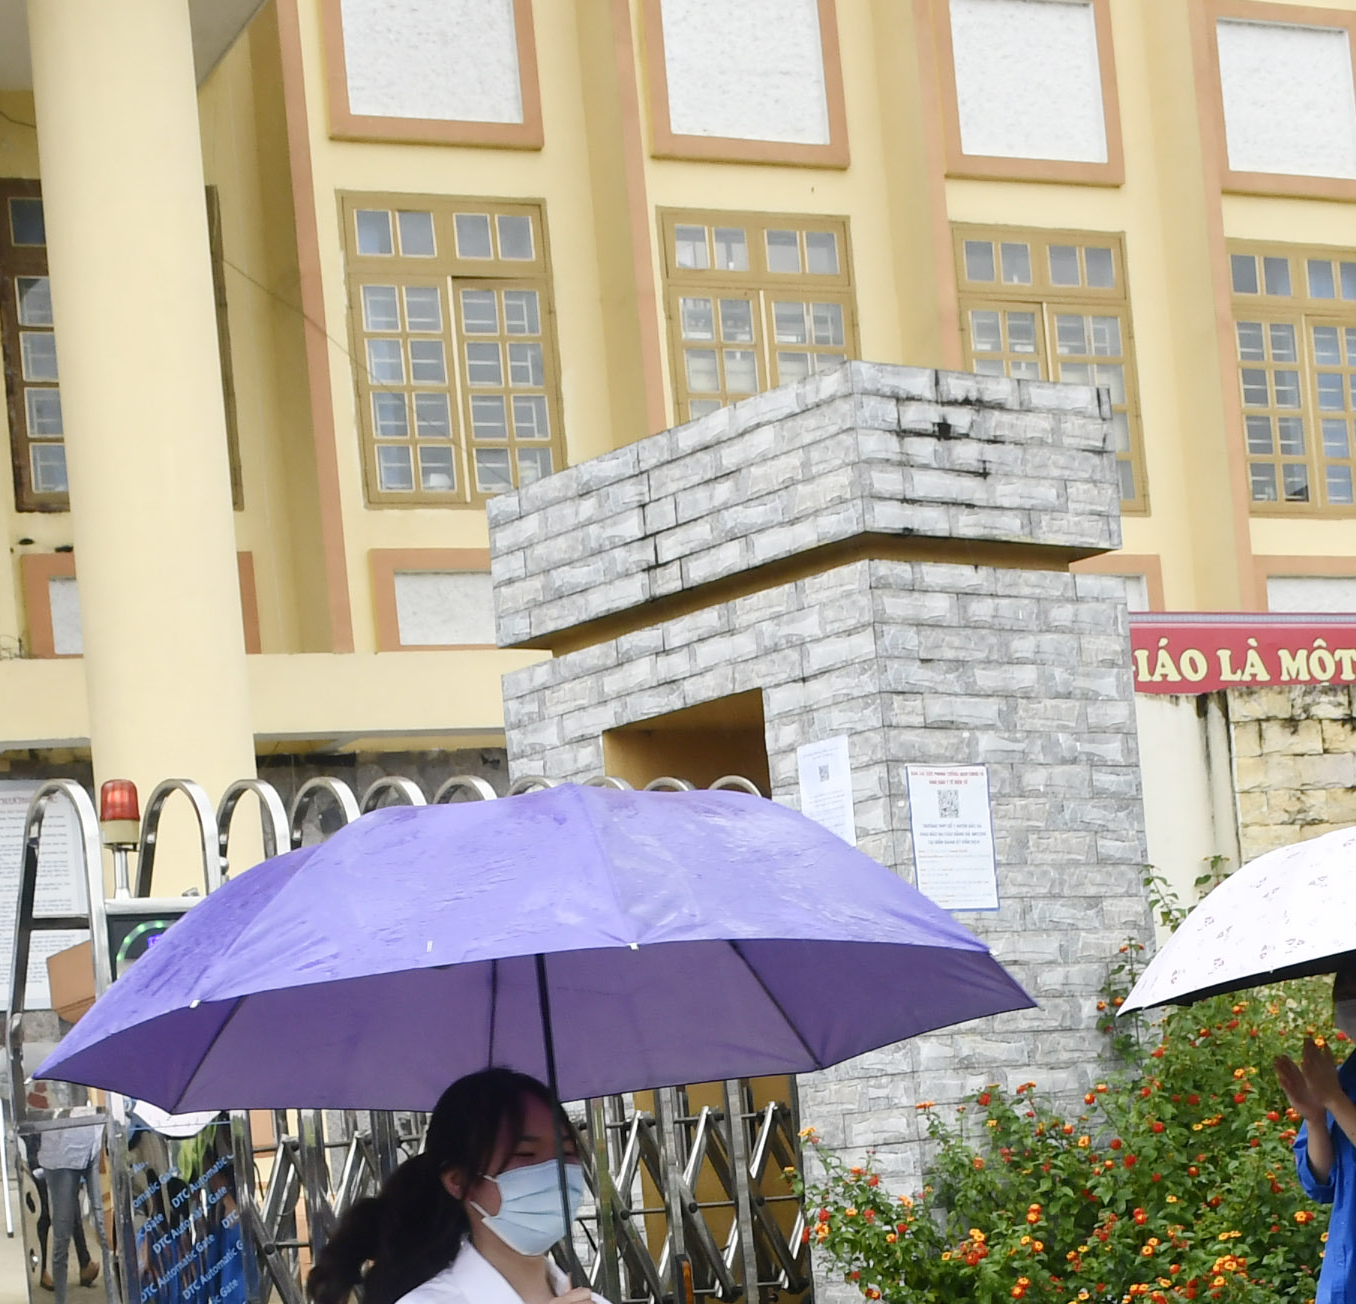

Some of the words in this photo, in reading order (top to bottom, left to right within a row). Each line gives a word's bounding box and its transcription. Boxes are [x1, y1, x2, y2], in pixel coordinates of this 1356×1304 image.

[1131, 637, 1208, 682] IÁO
[1216, 637, 1271, 681] LÀ
[132, 1181, 160, 1208] omatic
[171, 1188, 191, 1208] DTC
[190, 1156, 228, 1193] Automatic
[144, 1213, 165, 1232] Gate
[152, 1234, 172, 1254] DTC
[208, 1186, 228, 1205] Gate
[221, 1210, 240, 1229] DTC
[157, 1251, 198, 1289] Automatic
[195, 1233, 216, 1253] Gate
[182, 1280, 201, 1300] DTC
[200, 1249, 237, 1285] Automatic
[220, 1279, 239, 1298] Gate
